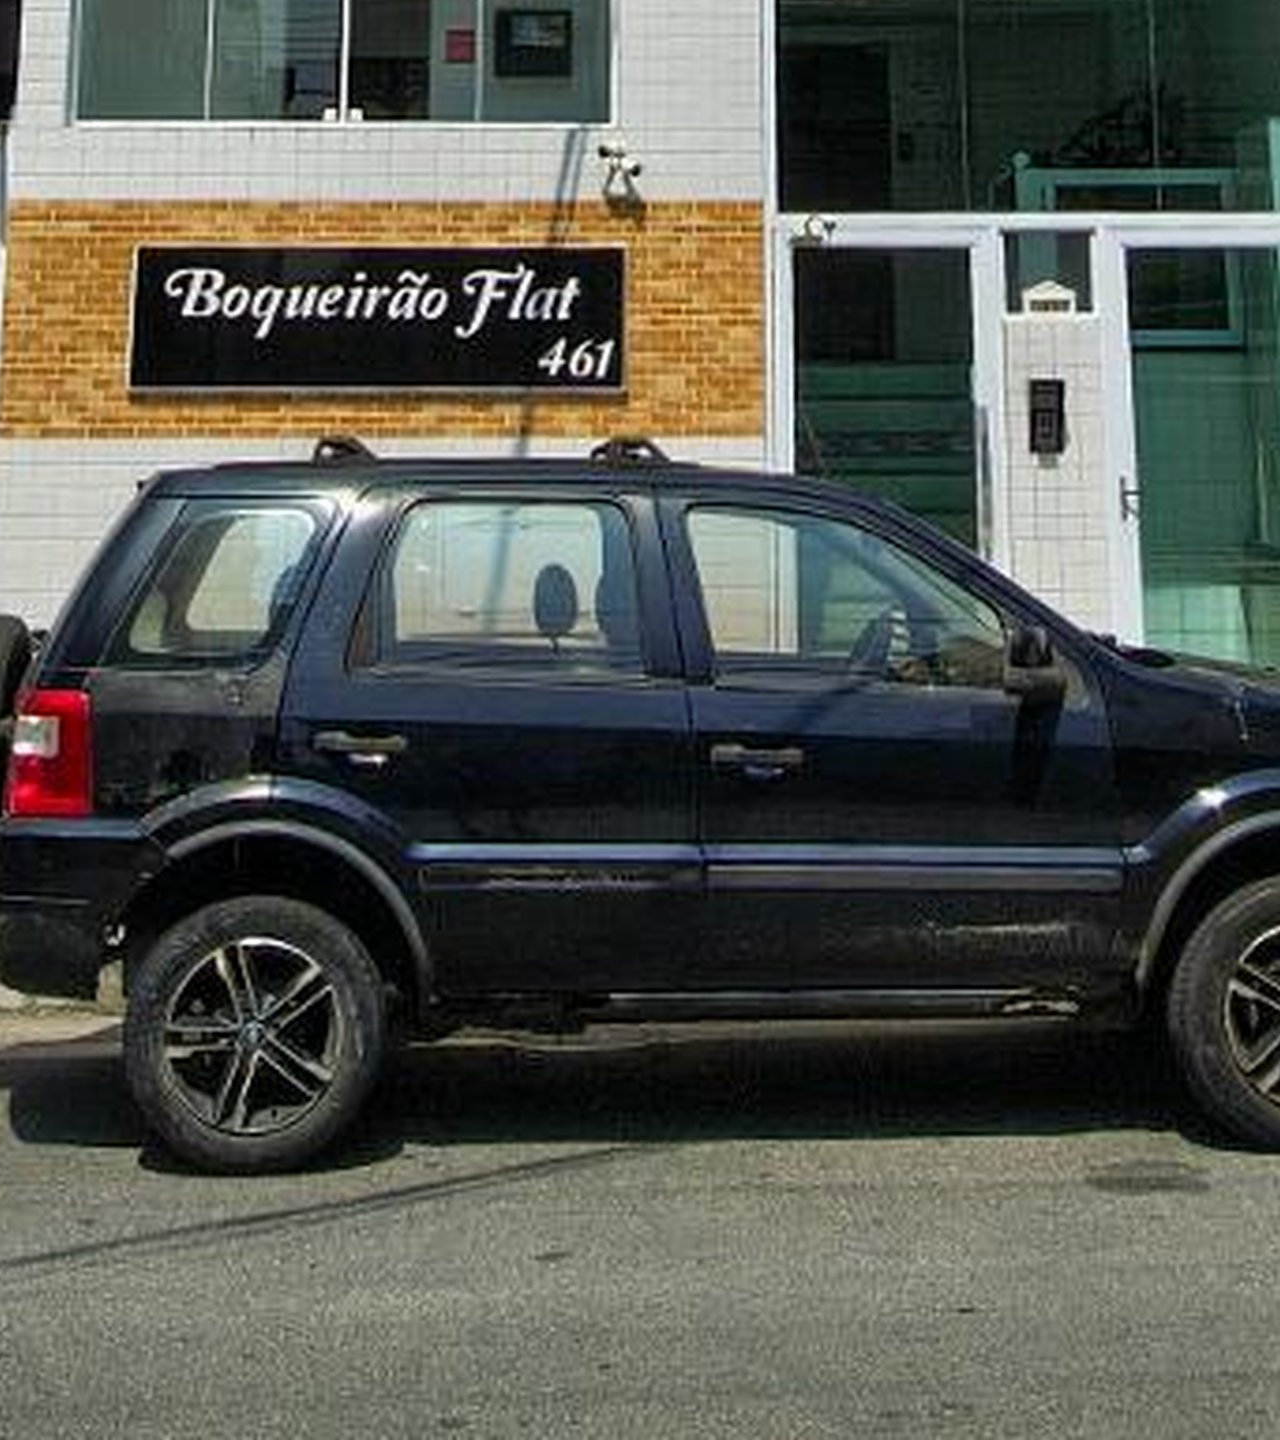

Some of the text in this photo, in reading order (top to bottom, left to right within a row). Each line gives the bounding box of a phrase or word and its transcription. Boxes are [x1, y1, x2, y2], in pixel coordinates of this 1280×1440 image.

[164, 263, 581, 339] Boqueirão Flat
[537, 337, 616, 379] 461
